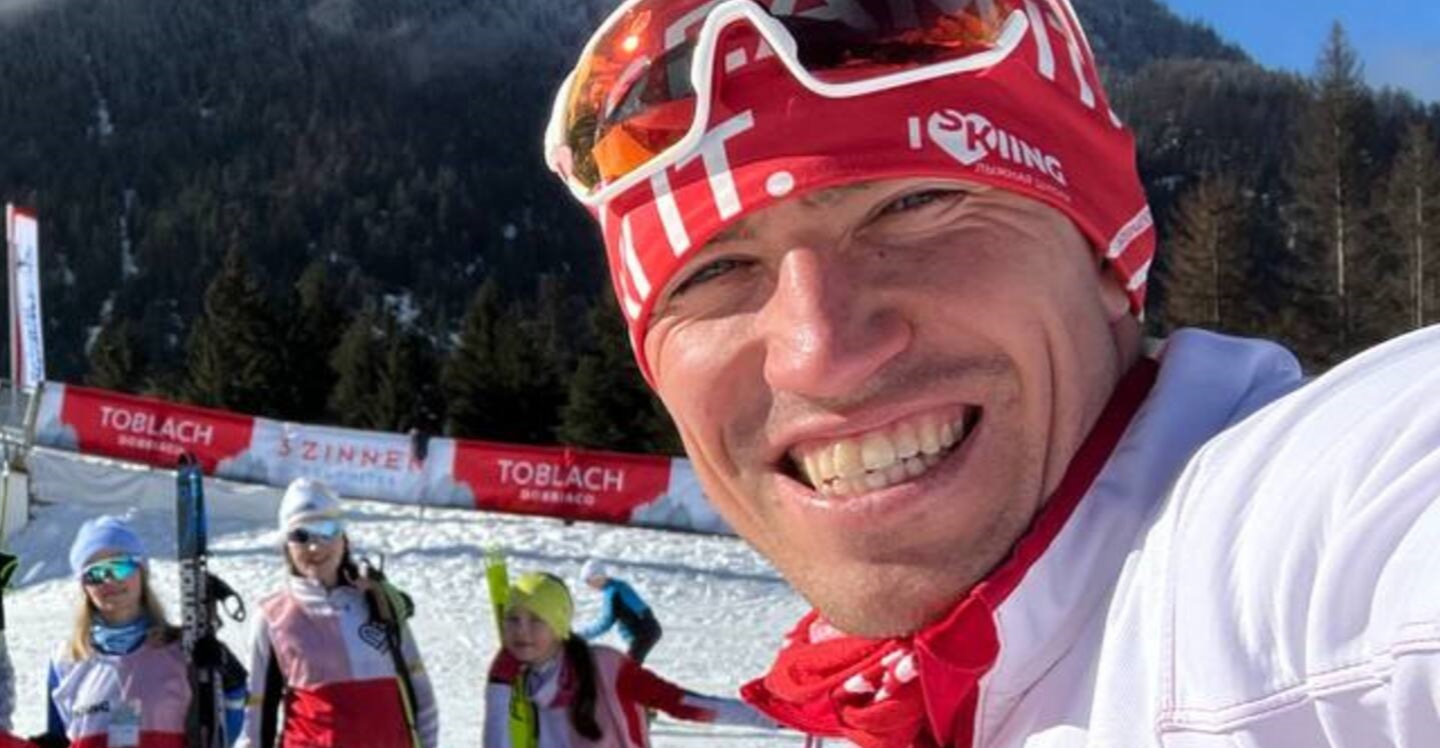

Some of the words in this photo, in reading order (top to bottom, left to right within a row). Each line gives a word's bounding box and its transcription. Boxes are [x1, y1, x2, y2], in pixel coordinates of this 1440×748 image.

[908, 116, 923, 149] I
[934, 108, 1068, 187] SKIING
[99, 406, 214, 445] TOBLACH
[497, 459, 625, 493] TOBLACH
